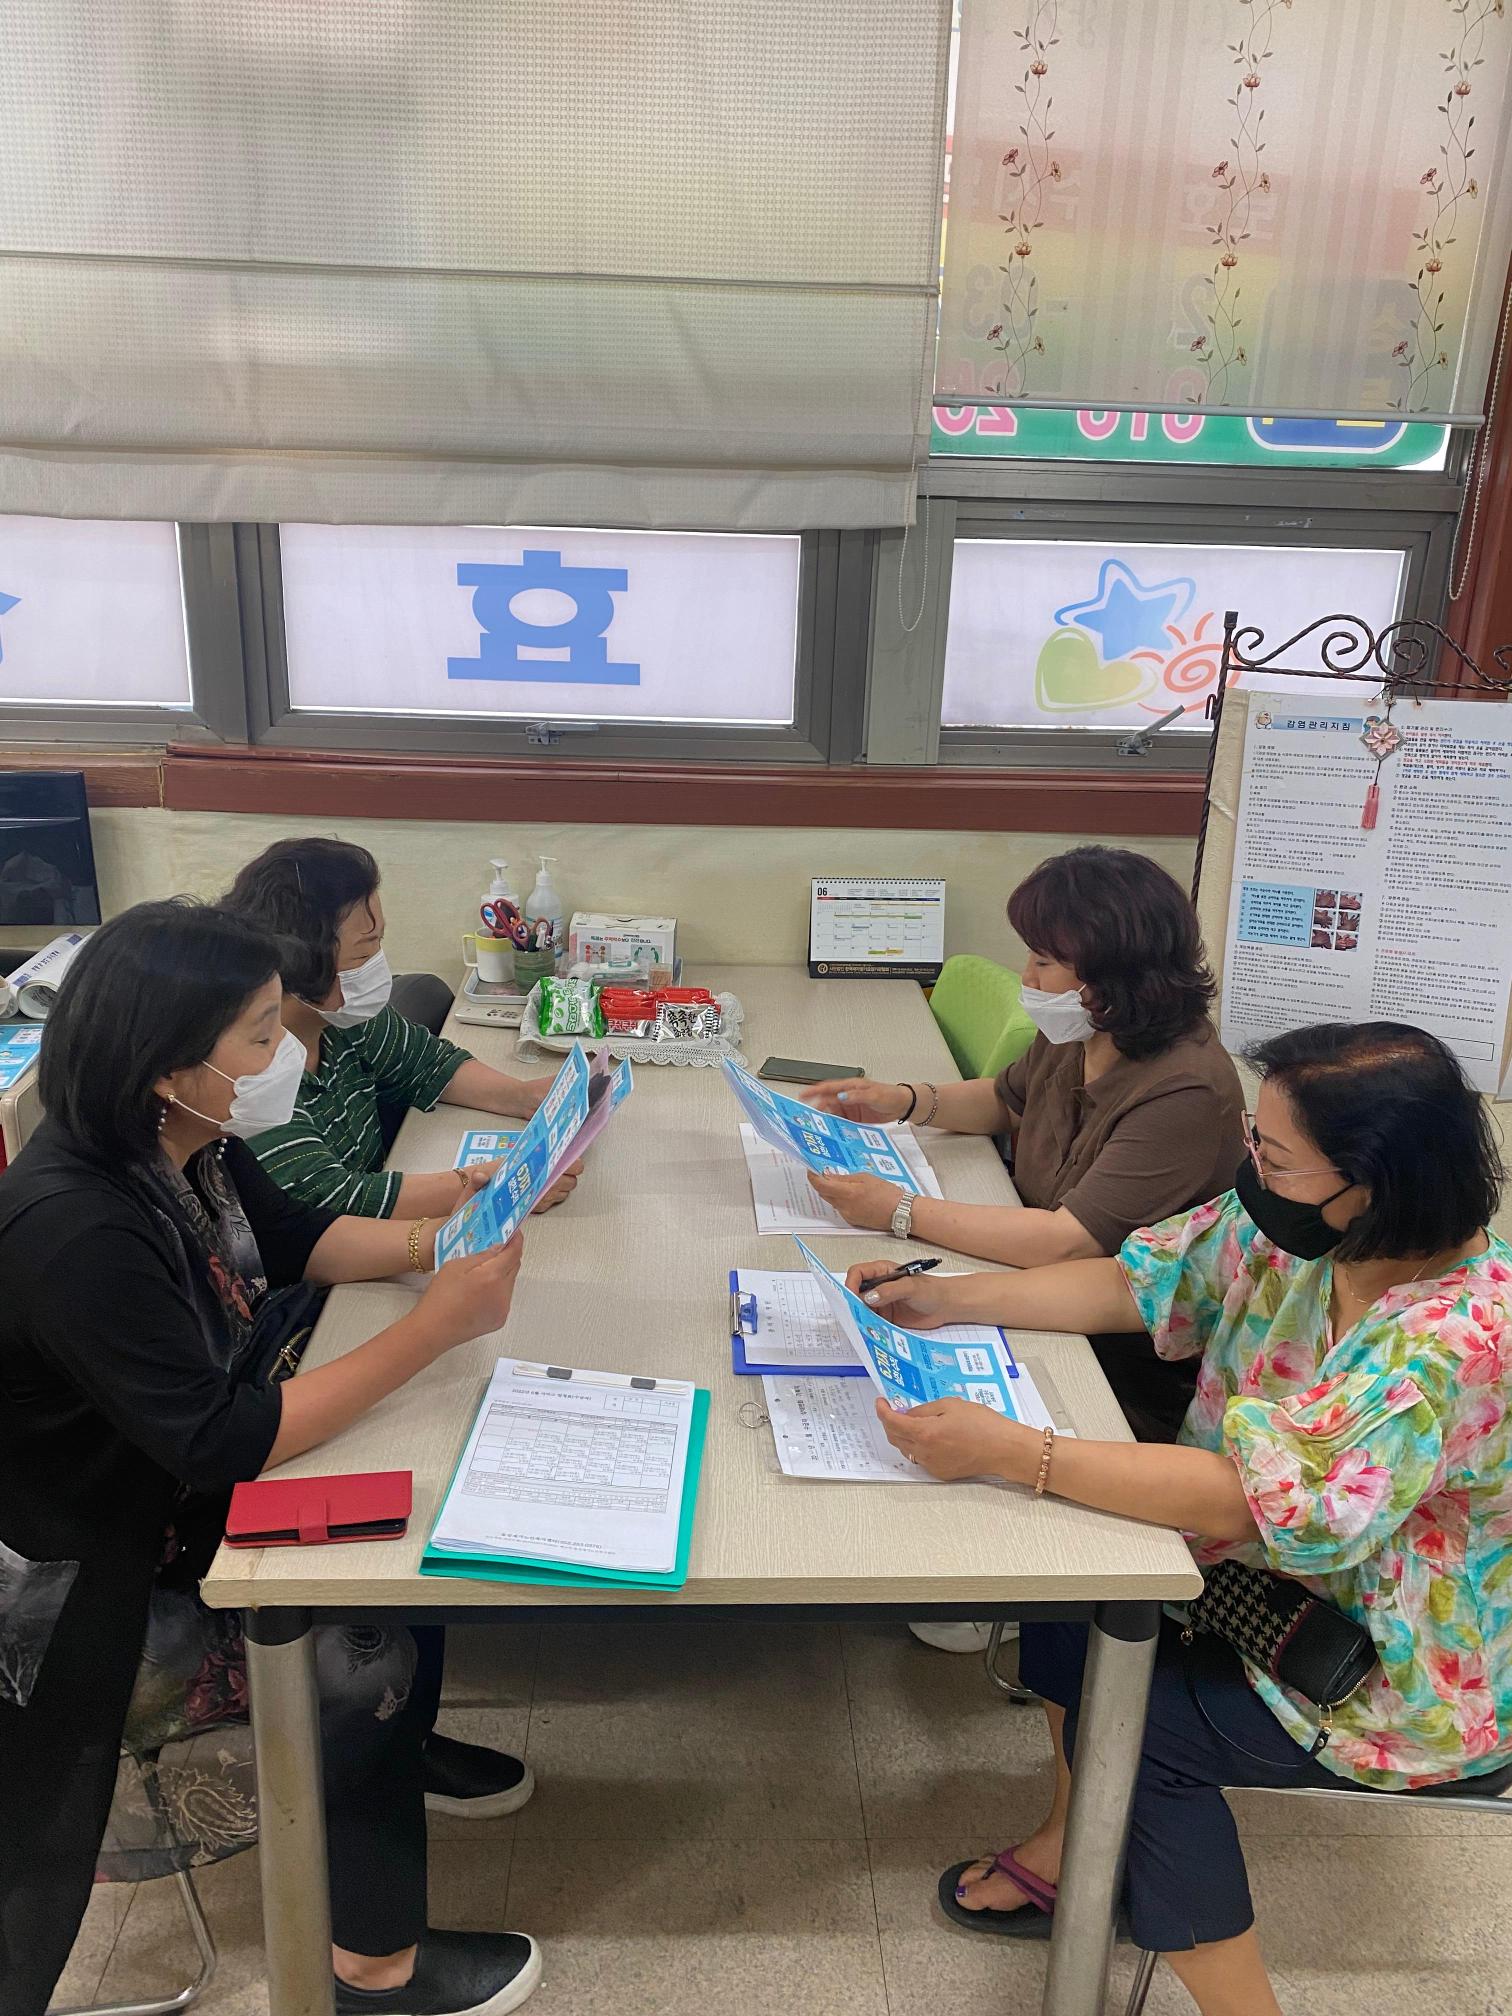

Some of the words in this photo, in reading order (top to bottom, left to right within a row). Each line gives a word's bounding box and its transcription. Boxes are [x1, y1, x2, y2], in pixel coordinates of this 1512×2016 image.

[447, 550, 640, 686] 효
[1287, 720, 1351, 731] 감염관리지침
[817, 887, 828, 896] 06
[667, 1010, 698, 1027] 촉촉한
[874, 1345, 893, 1380] 6가지
